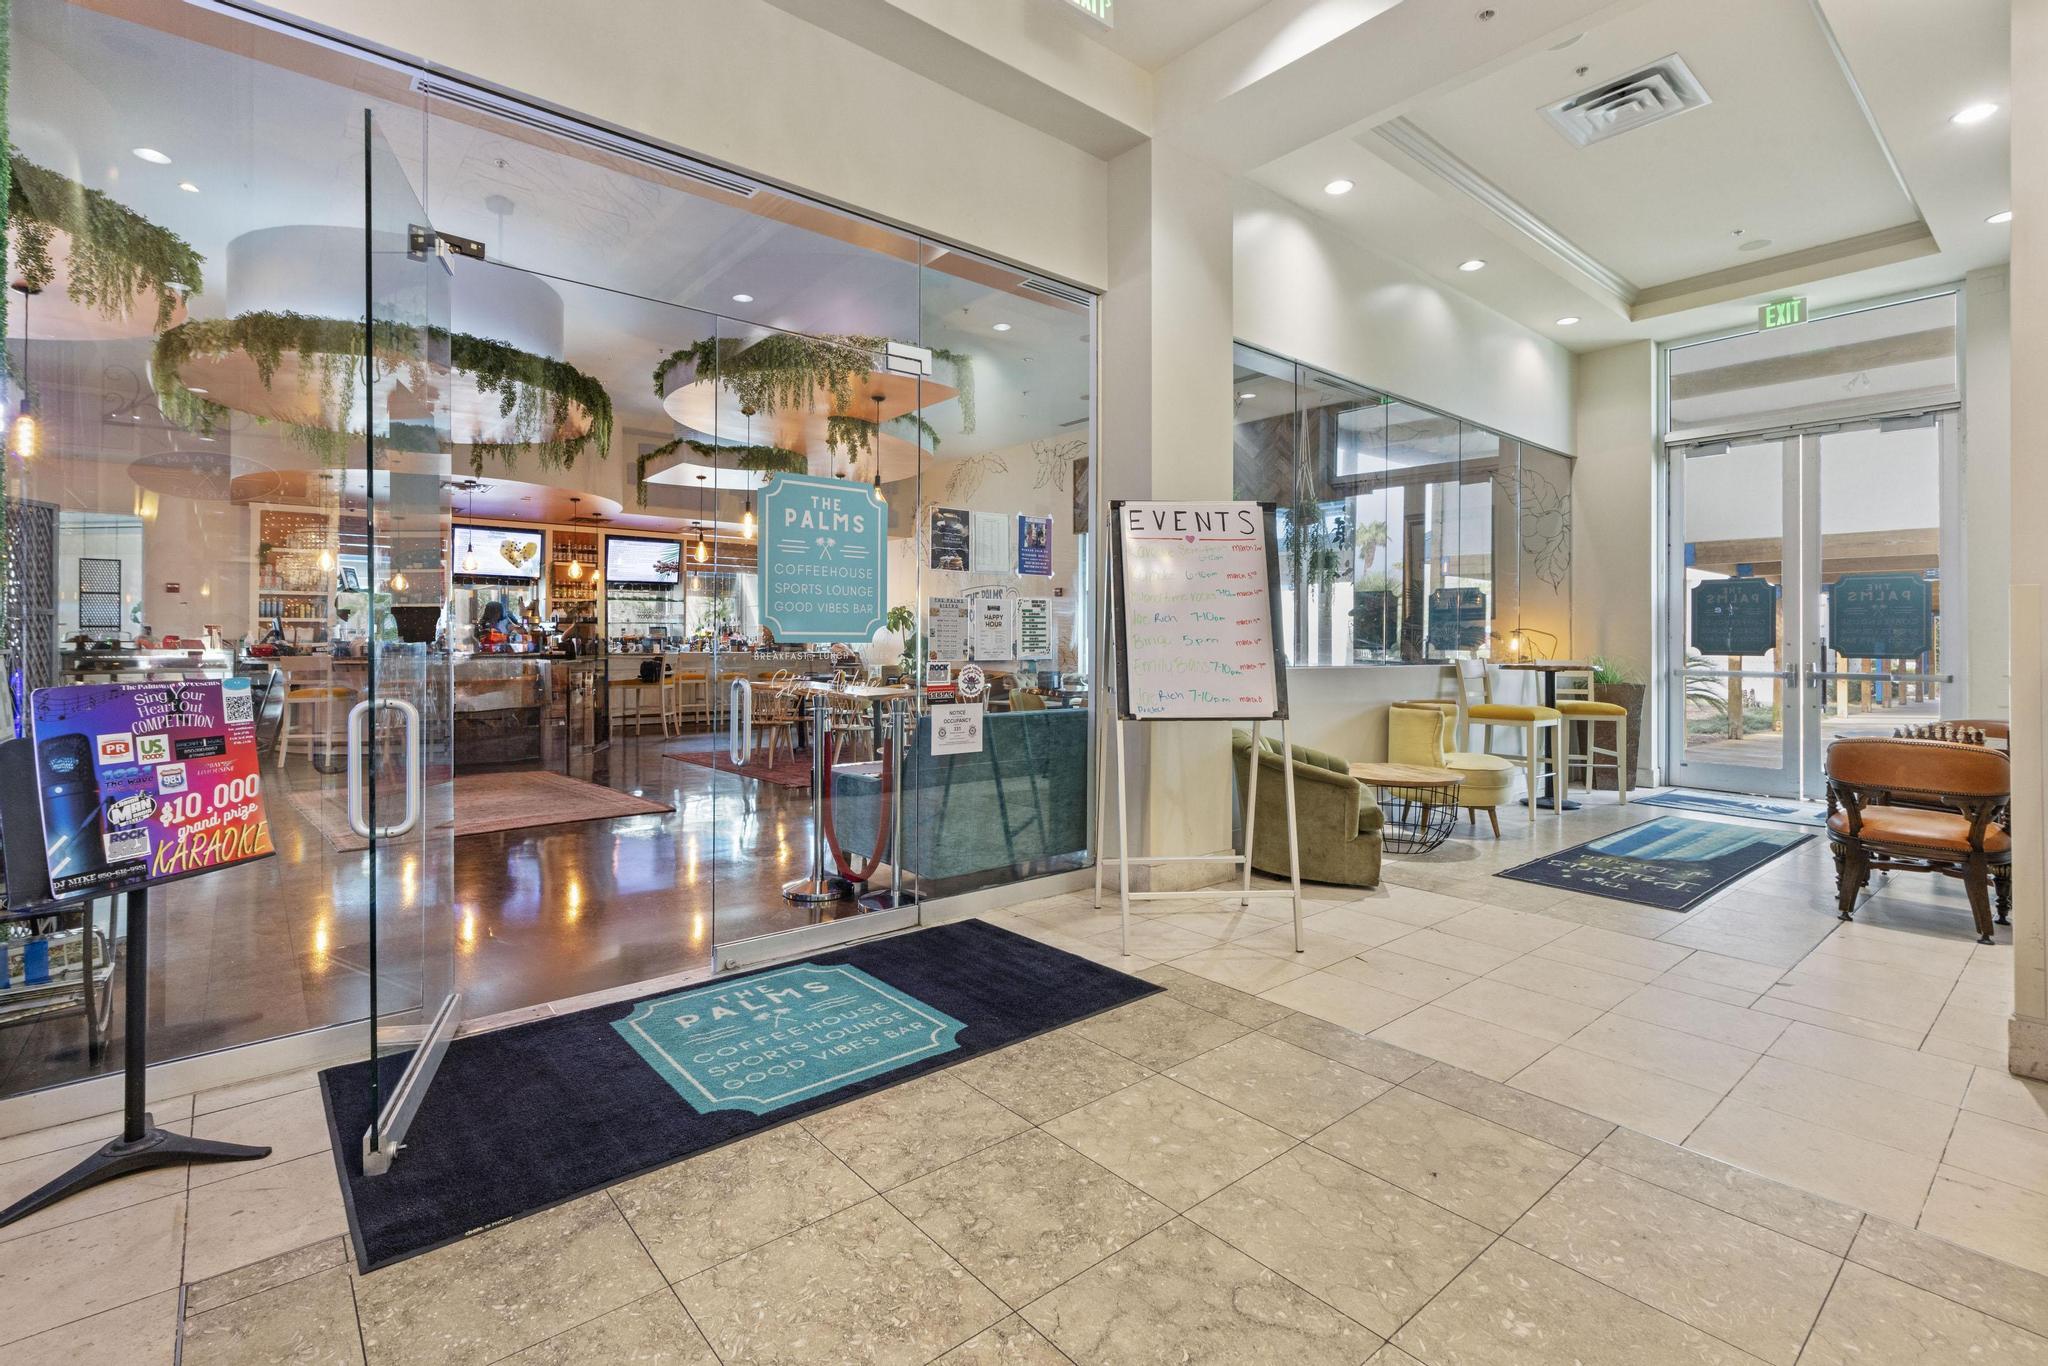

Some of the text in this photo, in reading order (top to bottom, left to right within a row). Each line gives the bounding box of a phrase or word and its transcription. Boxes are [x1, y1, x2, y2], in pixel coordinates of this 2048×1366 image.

[1765, 299, 1801, 328] EXIT
[811, 496, 841, 511] THE
[784, 508, 865, 533] PALMS
[1129, 509, 1256, 535] EVENTS
[774, 563, 873, 580] COFFEEHOUSE
[774, 582, 873, 598] SPORTS LOUNGE
[774, 601, 873, 614] GOOD VIBES BAR
[983, 613, 1003, 621] HAPPY
[753, 651, 849, 661] BREAKFAST LUNCH
[134, 682, 206, 706] Sing Your
[137, 700, 203, 718] Heart Out
[132, 714, 215, 735] COMPETITION
[106, 743, 126, 754] PR
[142, 752, 164, 760] FOODS
[160, 773, 260, 827] $10,000
[178, 803, 258, 844] grand prize
[110, 828, 146, 842] ROCK
[152, 820, 267, 877] KARAOKE
[53, 881, 66, 889] DJ
[67, 873, 97, 886] MIKE
[718, 983, 776, 1004] THE
[674, 980, 830, 1029] PALMS
[693, 1000, 890, 1065] COFFEEHOUSE
[707, 1011, 906, 1078] SPORTS LOUNGE
[723, 1020, 927, 1090] GOOD VIBES BAR
